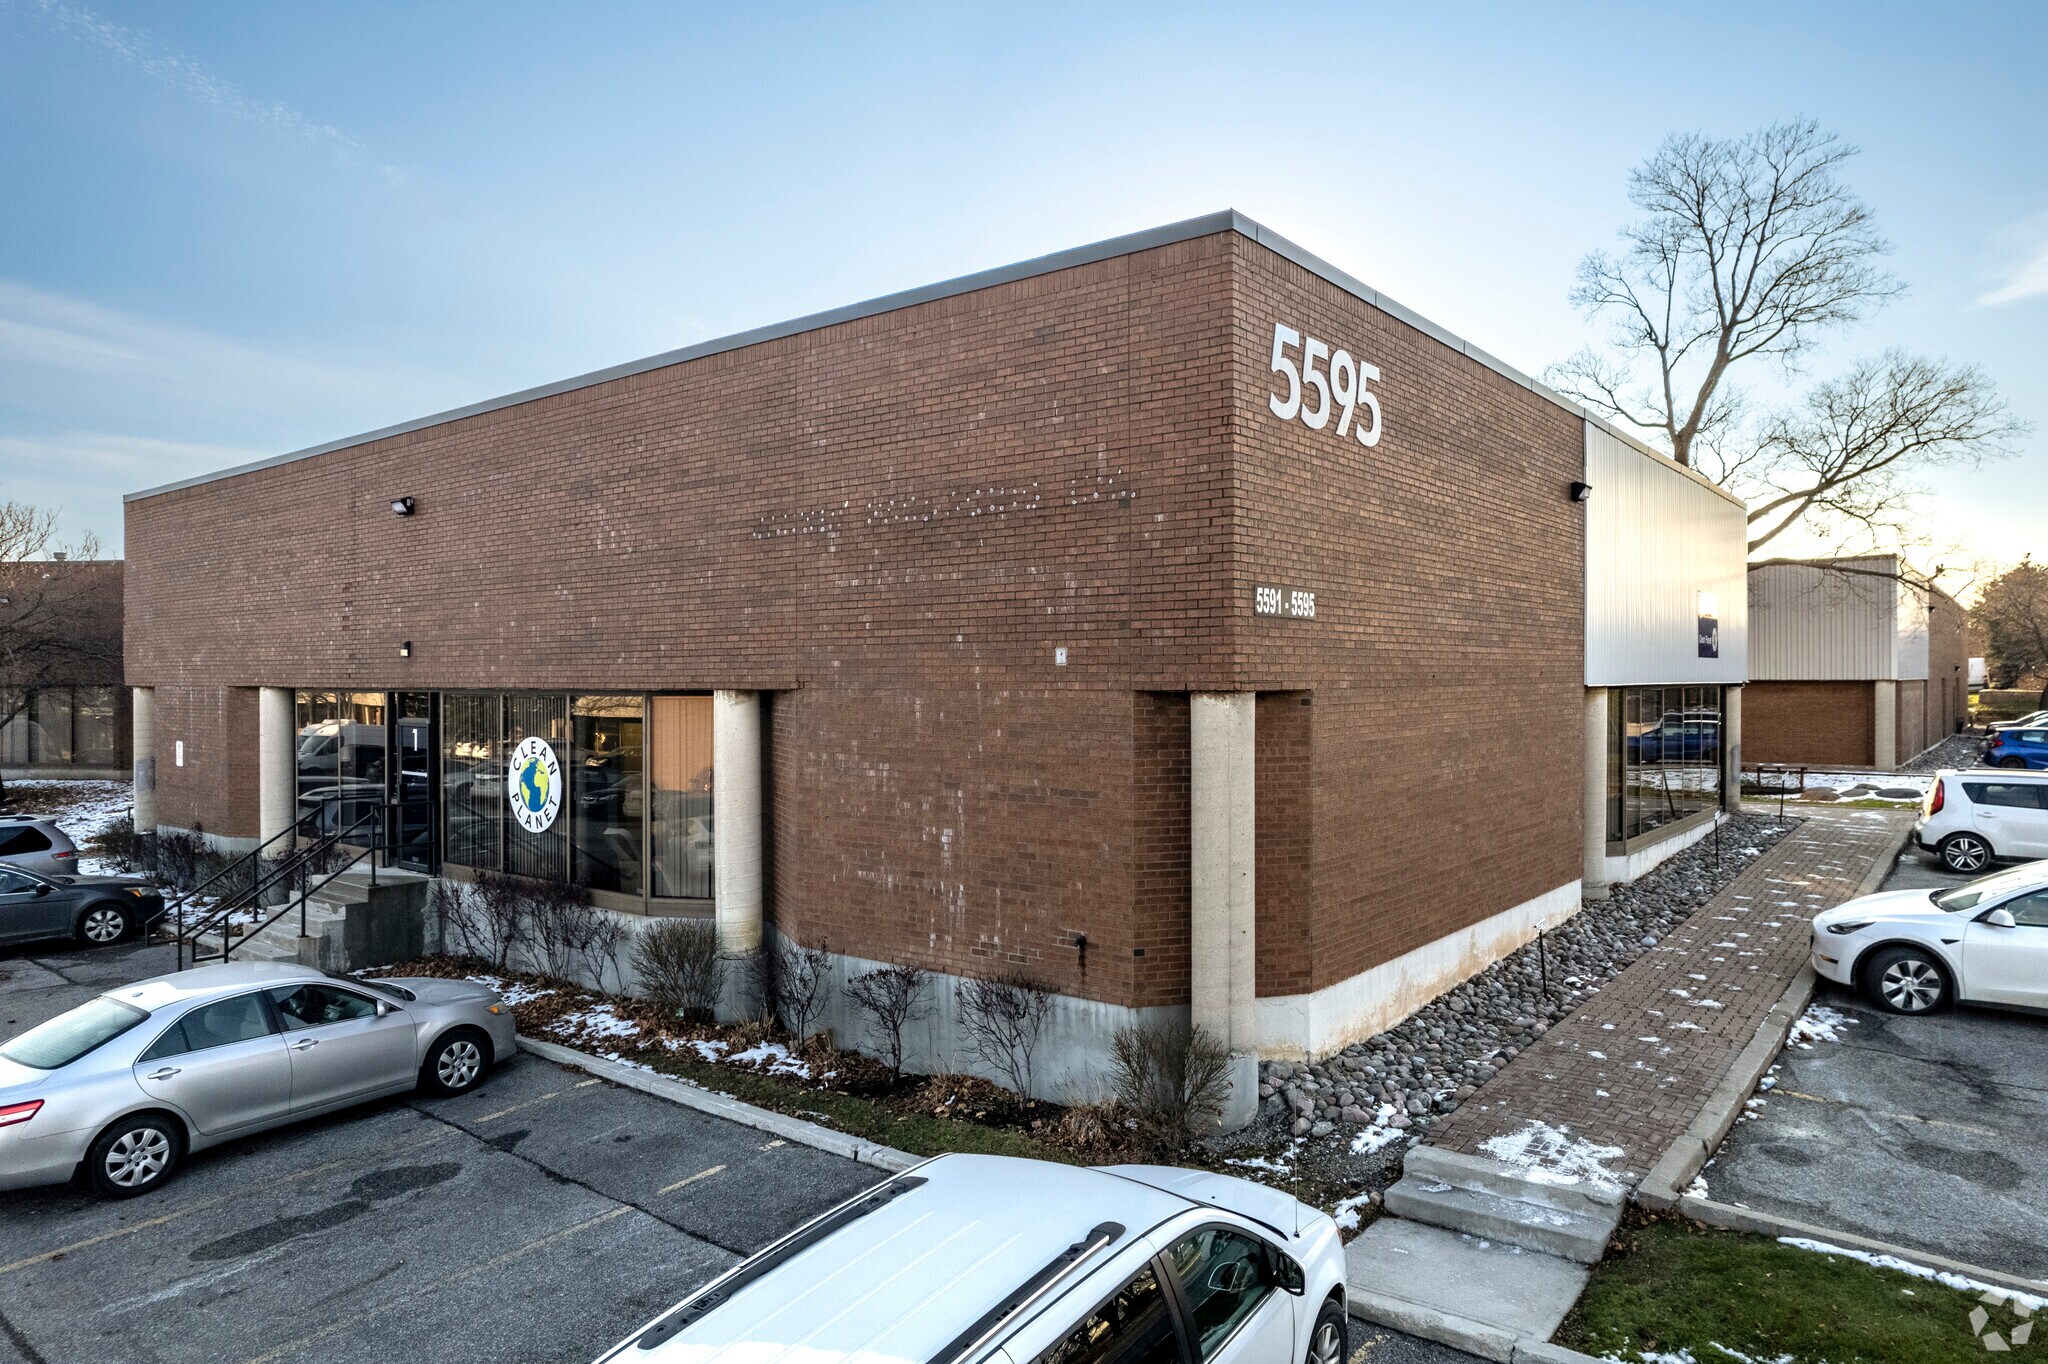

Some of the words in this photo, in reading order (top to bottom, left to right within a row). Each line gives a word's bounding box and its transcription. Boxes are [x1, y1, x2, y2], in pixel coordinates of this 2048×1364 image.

[1269, 322, 1382, 447] 5595
[1256, 587, 1282, 614] 5591
[1291, 590, 1315, 617] 5595
[412, 728, 418, 751] 1
[513, 741, 557, 776] CLEAN
[512, 792, 557, 829] PLANET
